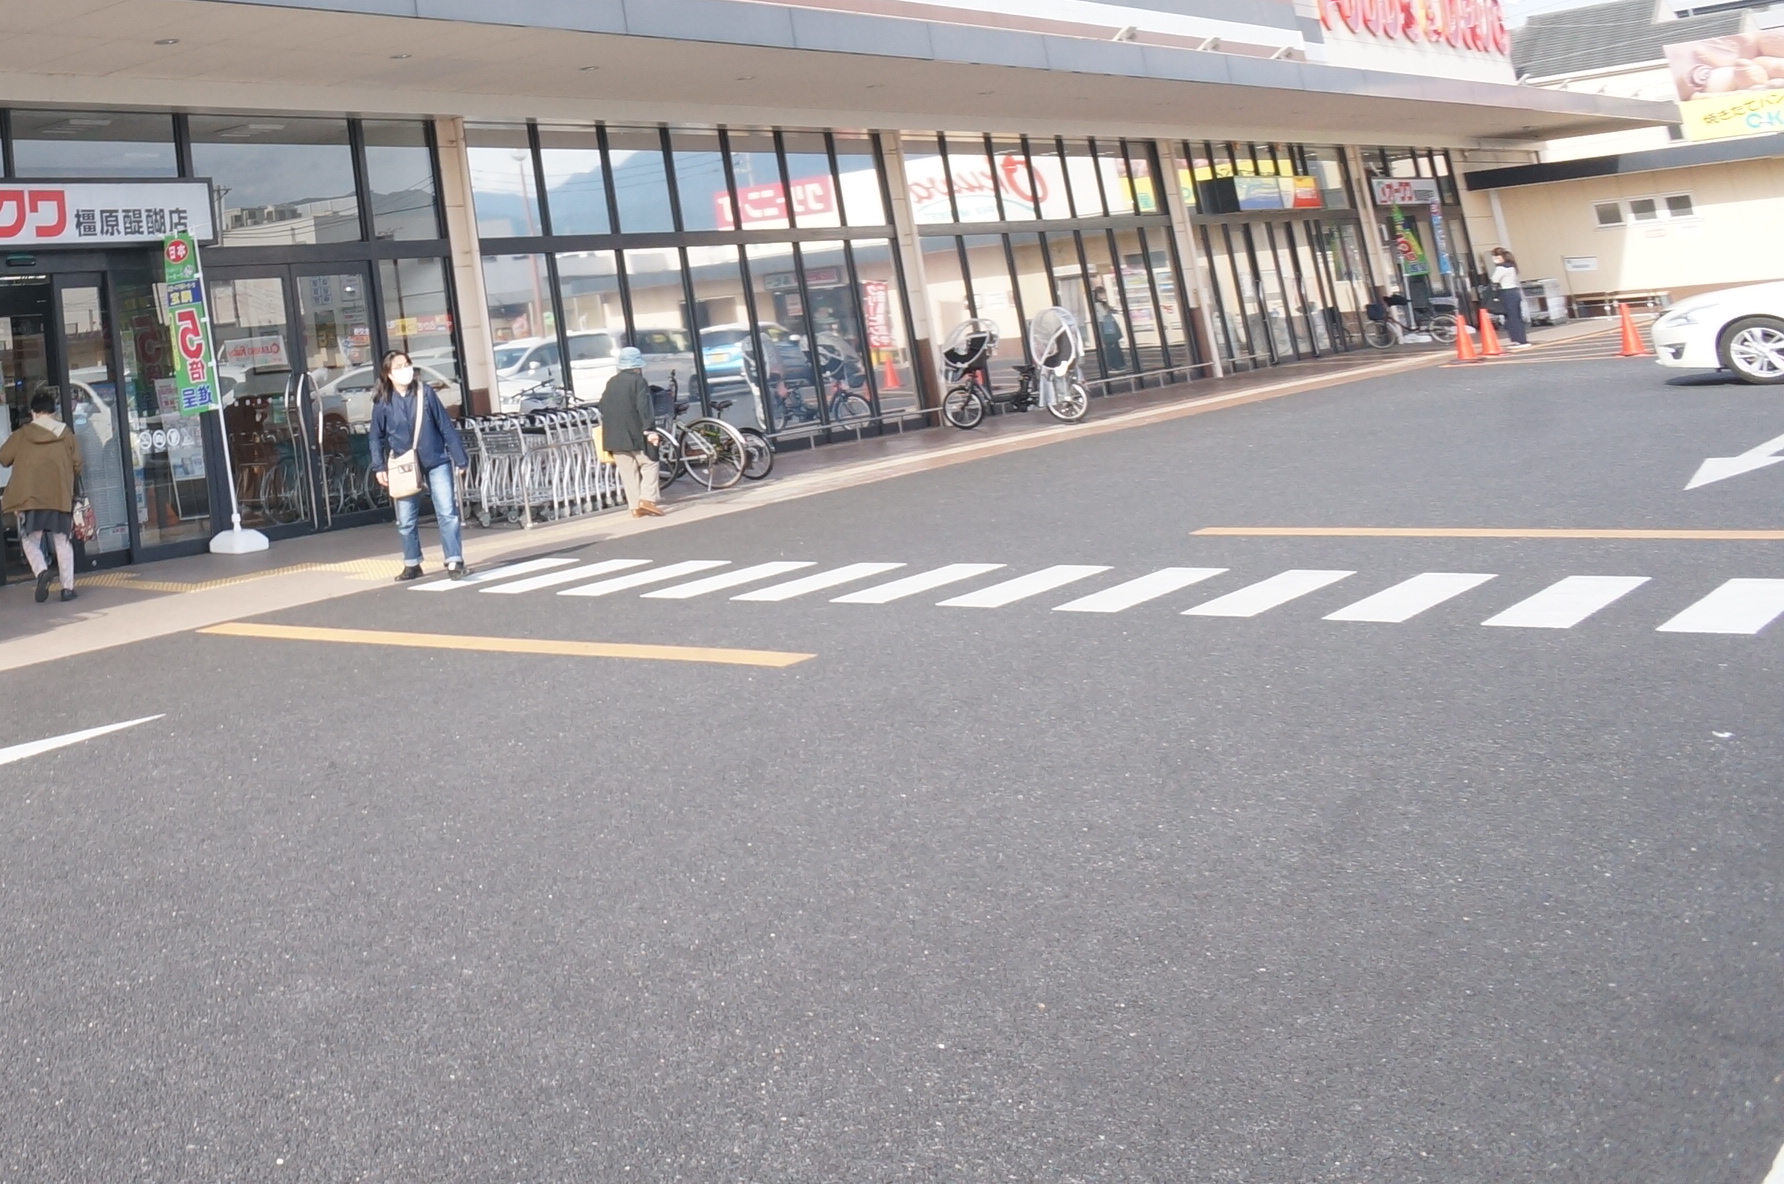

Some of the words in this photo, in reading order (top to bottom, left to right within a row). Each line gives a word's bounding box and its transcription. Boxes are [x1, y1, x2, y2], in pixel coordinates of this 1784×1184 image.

[74, 207, 190, 237] 橿原醍醐店
